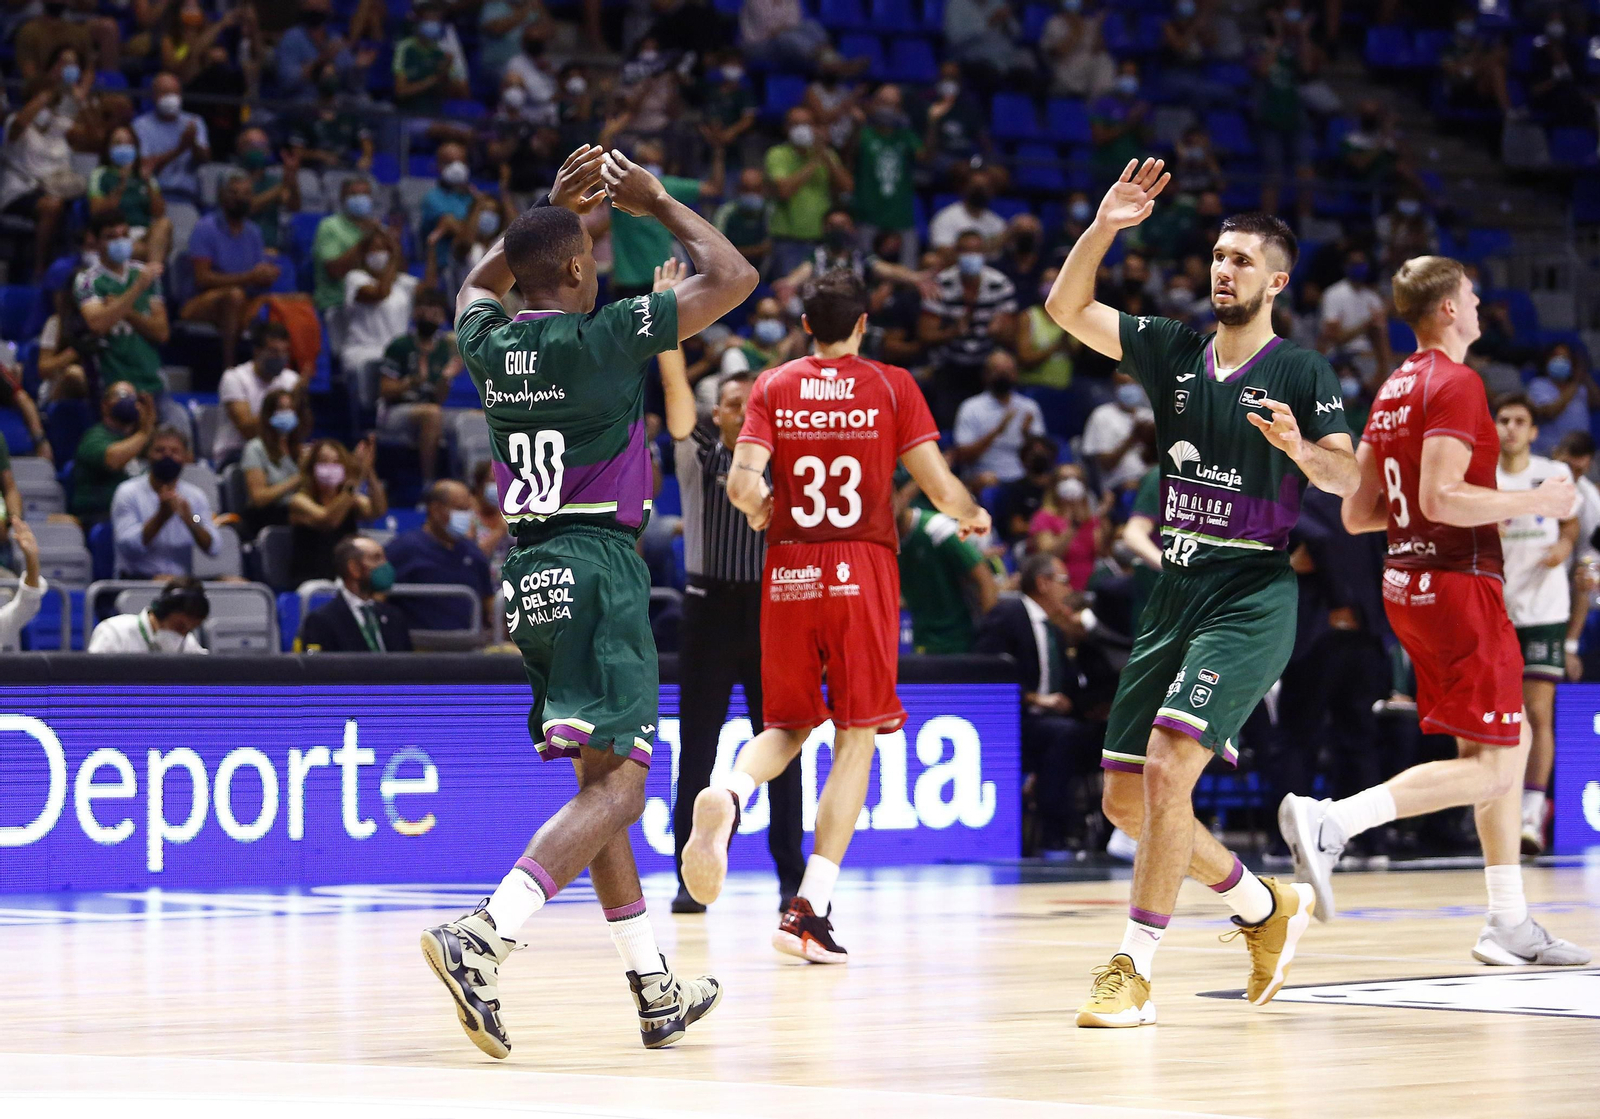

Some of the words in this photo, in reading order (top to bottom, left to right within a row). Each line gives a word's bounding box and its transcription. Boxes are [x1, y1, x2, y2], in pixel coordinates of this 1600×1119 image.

[505, 350, 538, 375] COLE
[800, 376, 855, 400] MUÑOZ
[793, 408, 879, 428] cenor
[503, 430, 566, 514] 30
[1196, 463, 1242, 486] Unicaja
[790, 455, 862, 528] 33
[1384, 457, 1410, 528] 8
[1178, 493, 1232, 516] MÁLAGA
[520, 568, 575, 592] COSTA
[521, 593, 547, 611] DEL
[548, 588, 574, 603] SOL
[0, 713, 439, 873] Deporte
